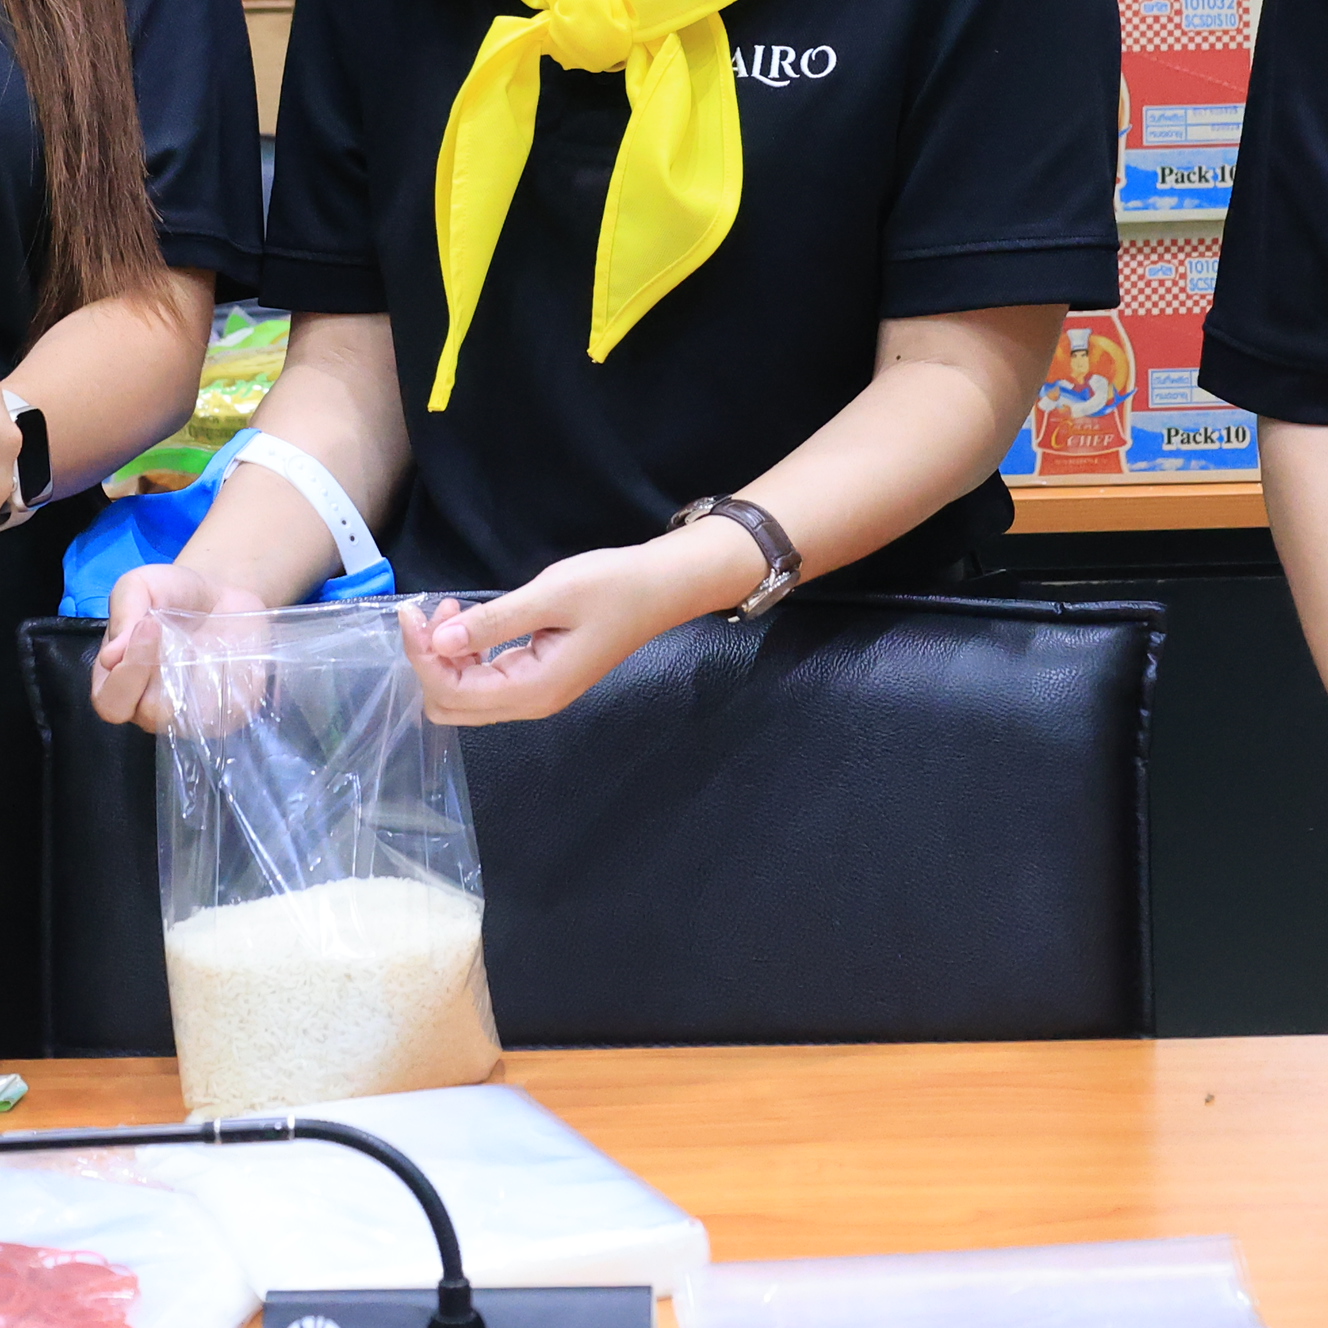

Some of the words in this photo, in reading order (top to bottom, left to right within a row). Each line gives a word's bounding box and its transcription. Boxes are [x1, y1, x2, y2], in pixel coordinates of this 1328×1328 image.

[1184, 14, 1237, 29] SCSDIS10
[1159, 166, 1210, 184] Pack
[1165, 426, 1216, 446] Pack
[1223, 426, 1247, 444] 10
